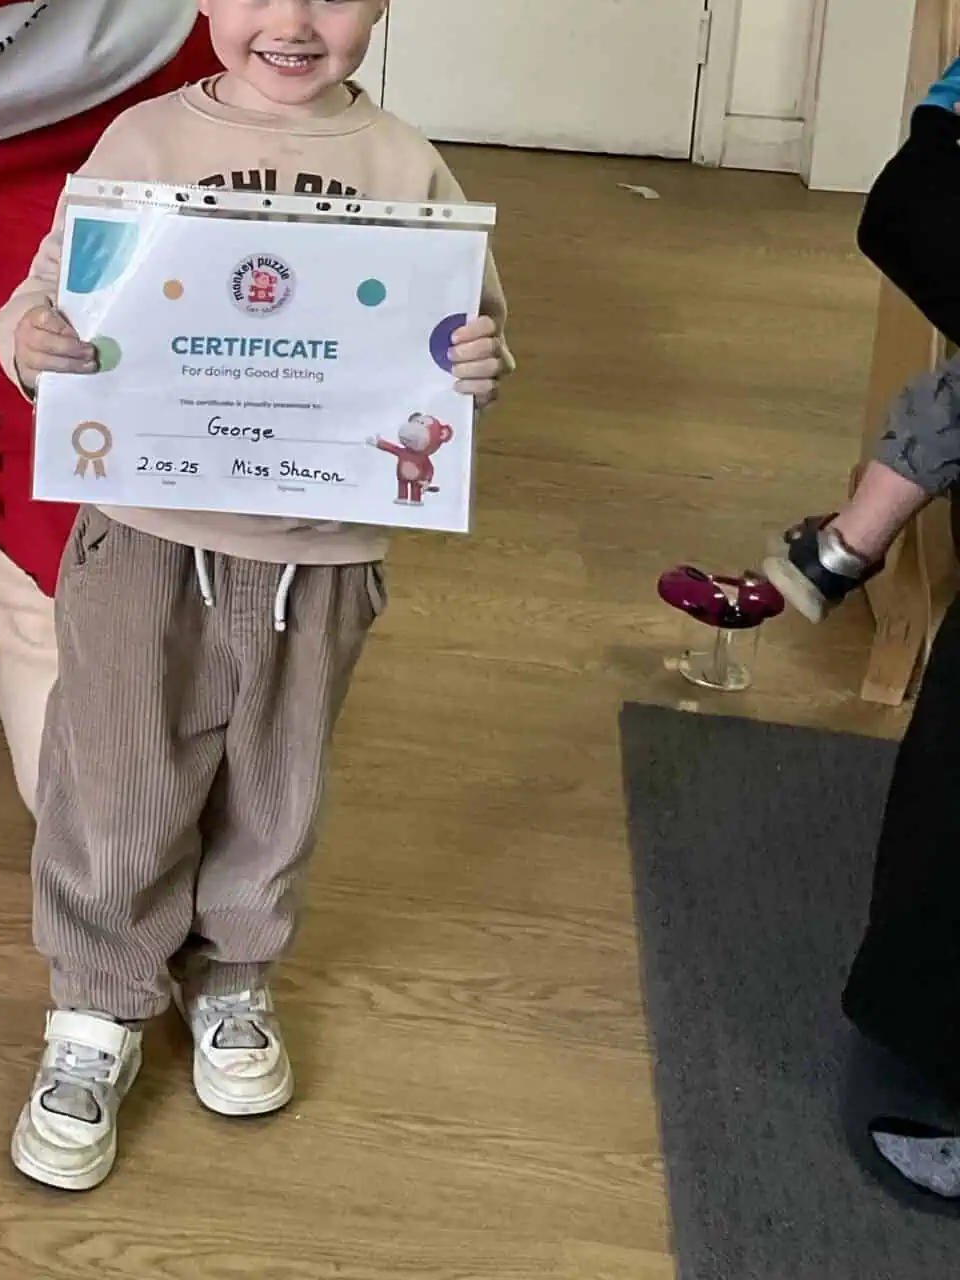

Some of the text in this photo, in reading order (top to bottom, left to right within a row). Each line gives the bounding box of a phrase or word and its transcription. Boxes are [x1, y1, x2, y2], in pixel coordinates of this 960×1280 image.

[232, 258, 254, 301] monkey
[257, 257, 290, 280] puzzle
[171, 335, 339, 360] CERTIFICATE
[182, 365, 324, 383] For doing Good Sitting
[207, 416, 275, 442] George
[231, 459, 345, 483] Miss Sharon
